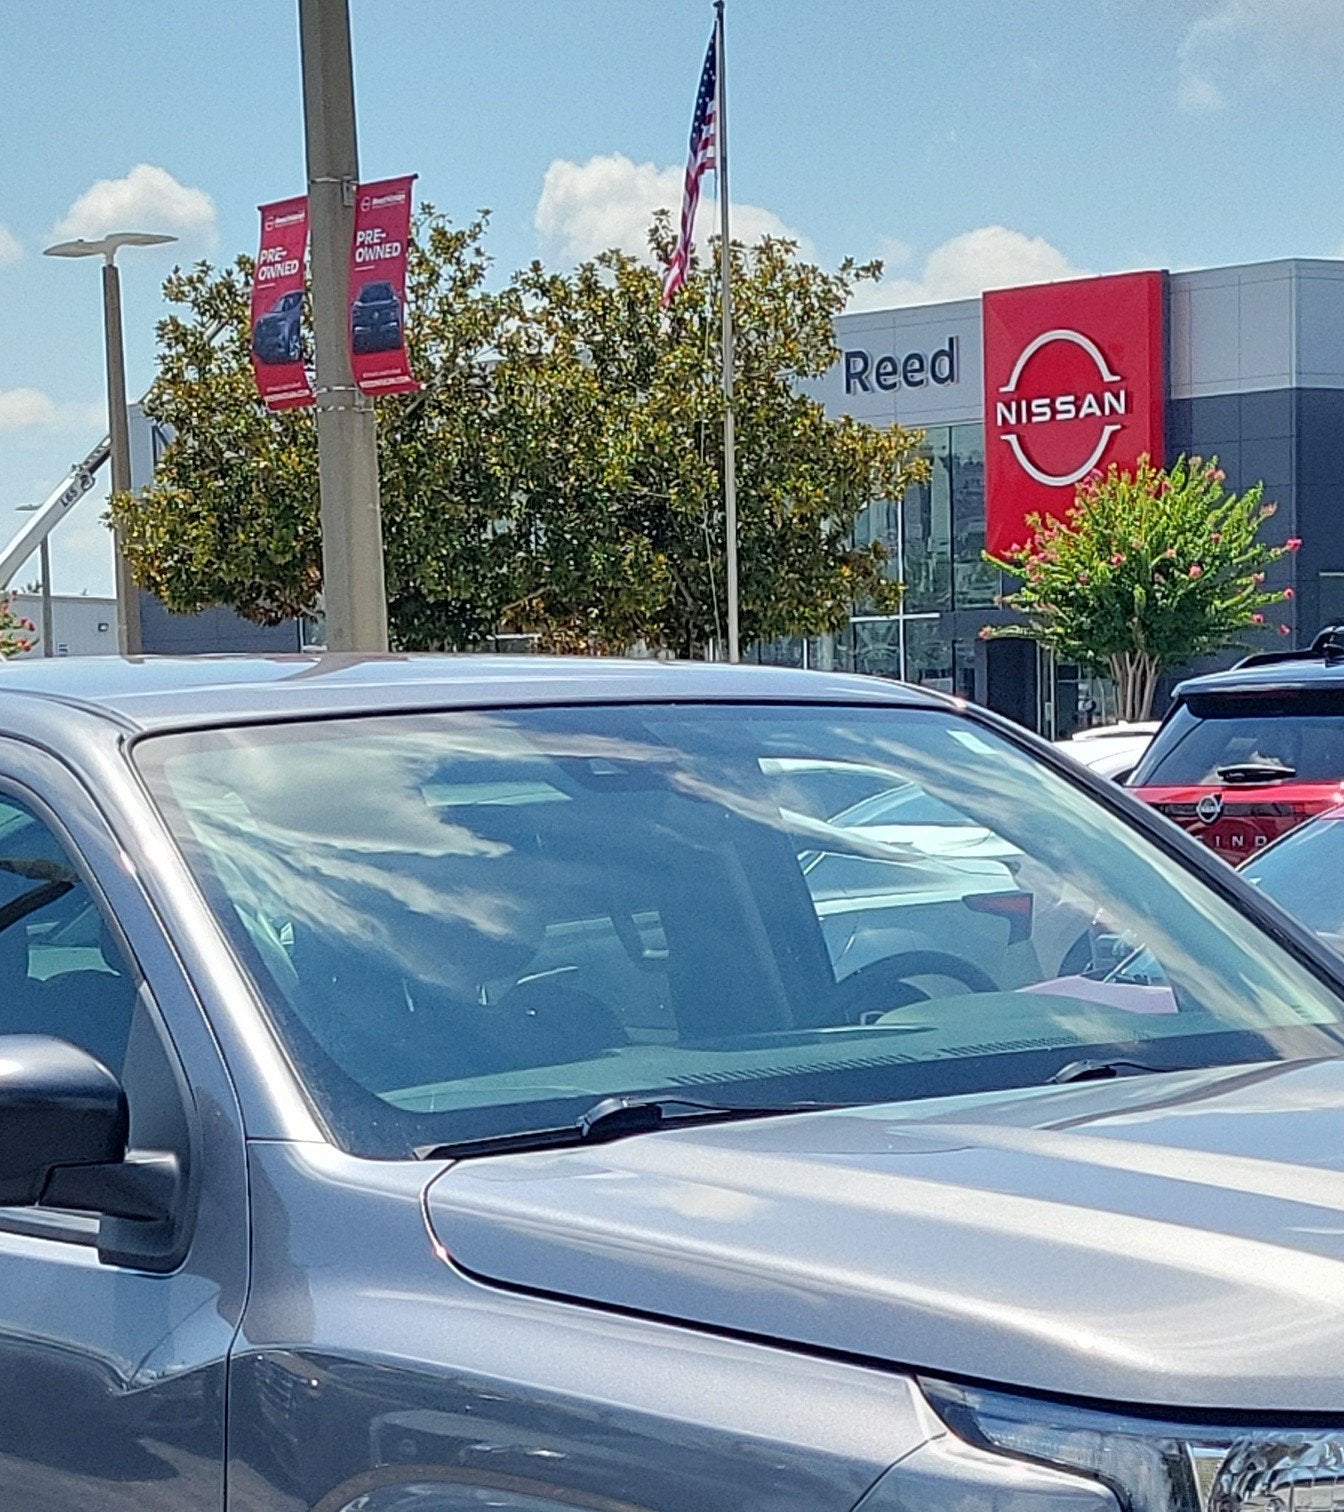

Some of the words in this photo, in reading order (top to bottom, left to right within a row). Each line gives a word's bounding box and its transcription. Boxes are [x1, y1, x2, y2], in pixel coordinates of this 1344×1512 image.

[356, 228, 386, 246] PRE-
[259, 246, 287, 264] PRE-
[355, 242, 401, 262] OWNED
[258, 260, 299, 280] OWNED
[844, 336, 958, 394] Reed
[996, 390, 1127, 427] NISSAN
